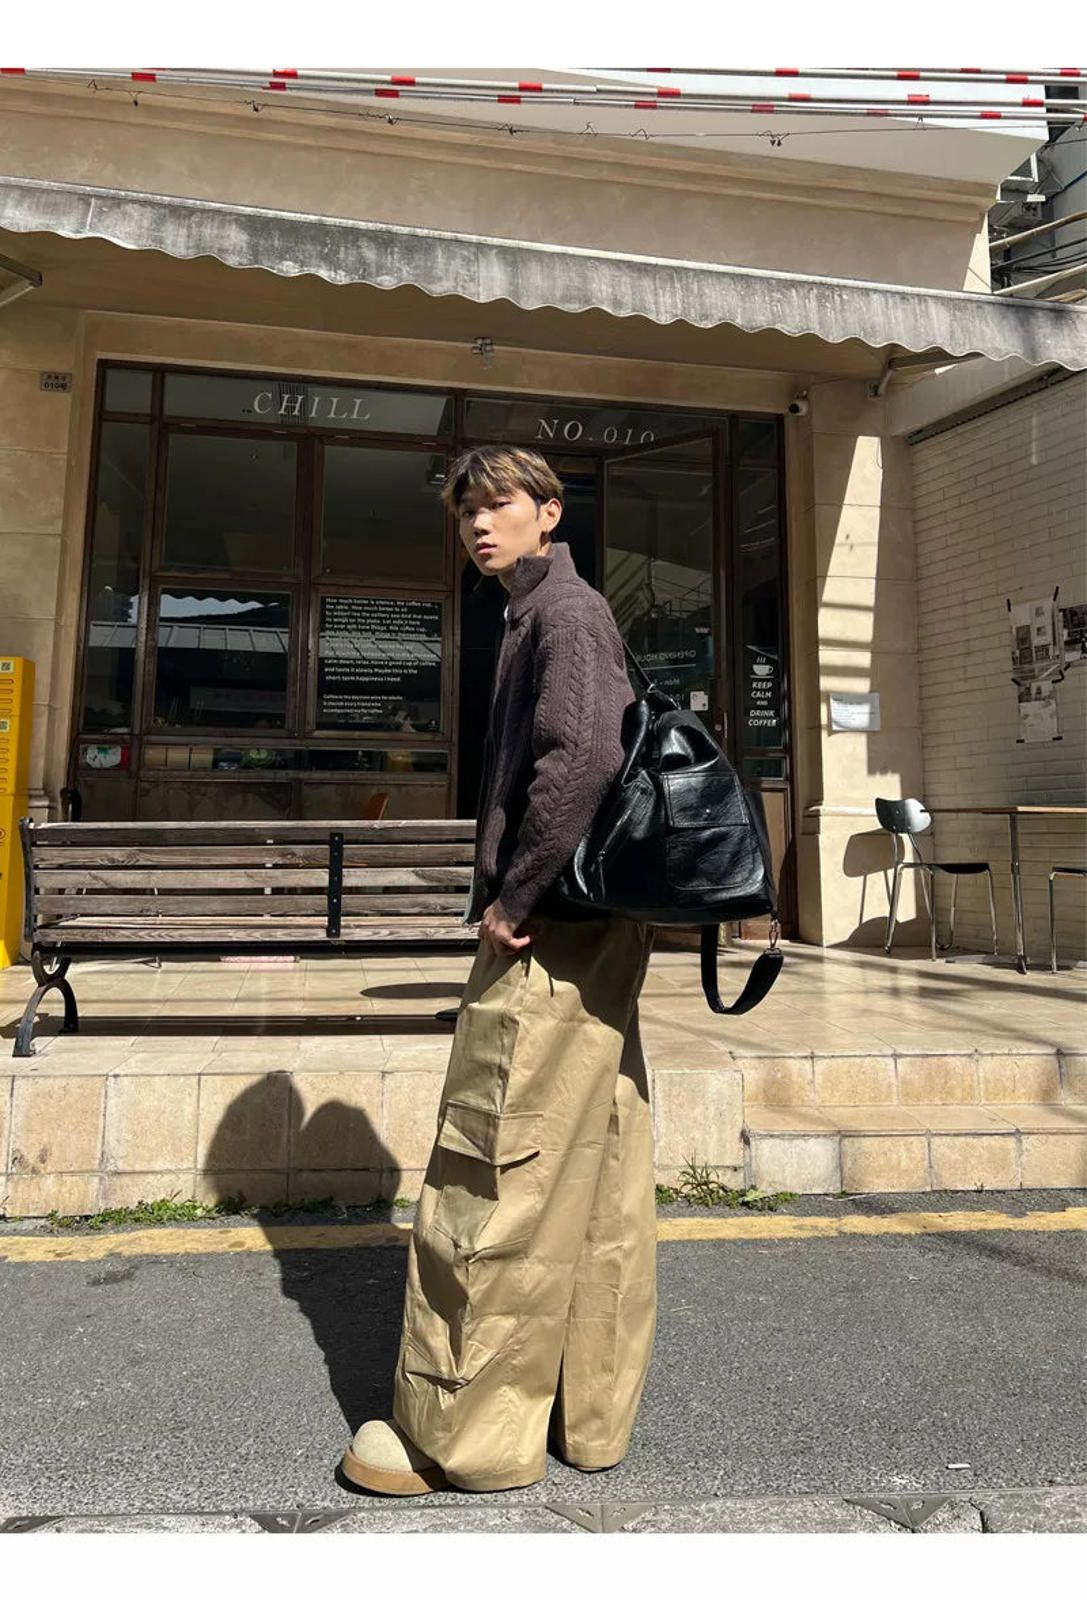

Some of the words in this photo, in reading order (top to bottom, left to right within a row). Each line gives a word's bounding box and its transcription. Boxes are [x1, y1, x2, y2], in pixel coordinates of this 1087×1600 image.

[253, 392, 371, 419] CHILL
[752, 682, 773, 690] KEEP
[751, 691, 773, 699] CALM
[750, 709, 776, 718] DRINK
[748, 719, 777, 728] COFFEE
